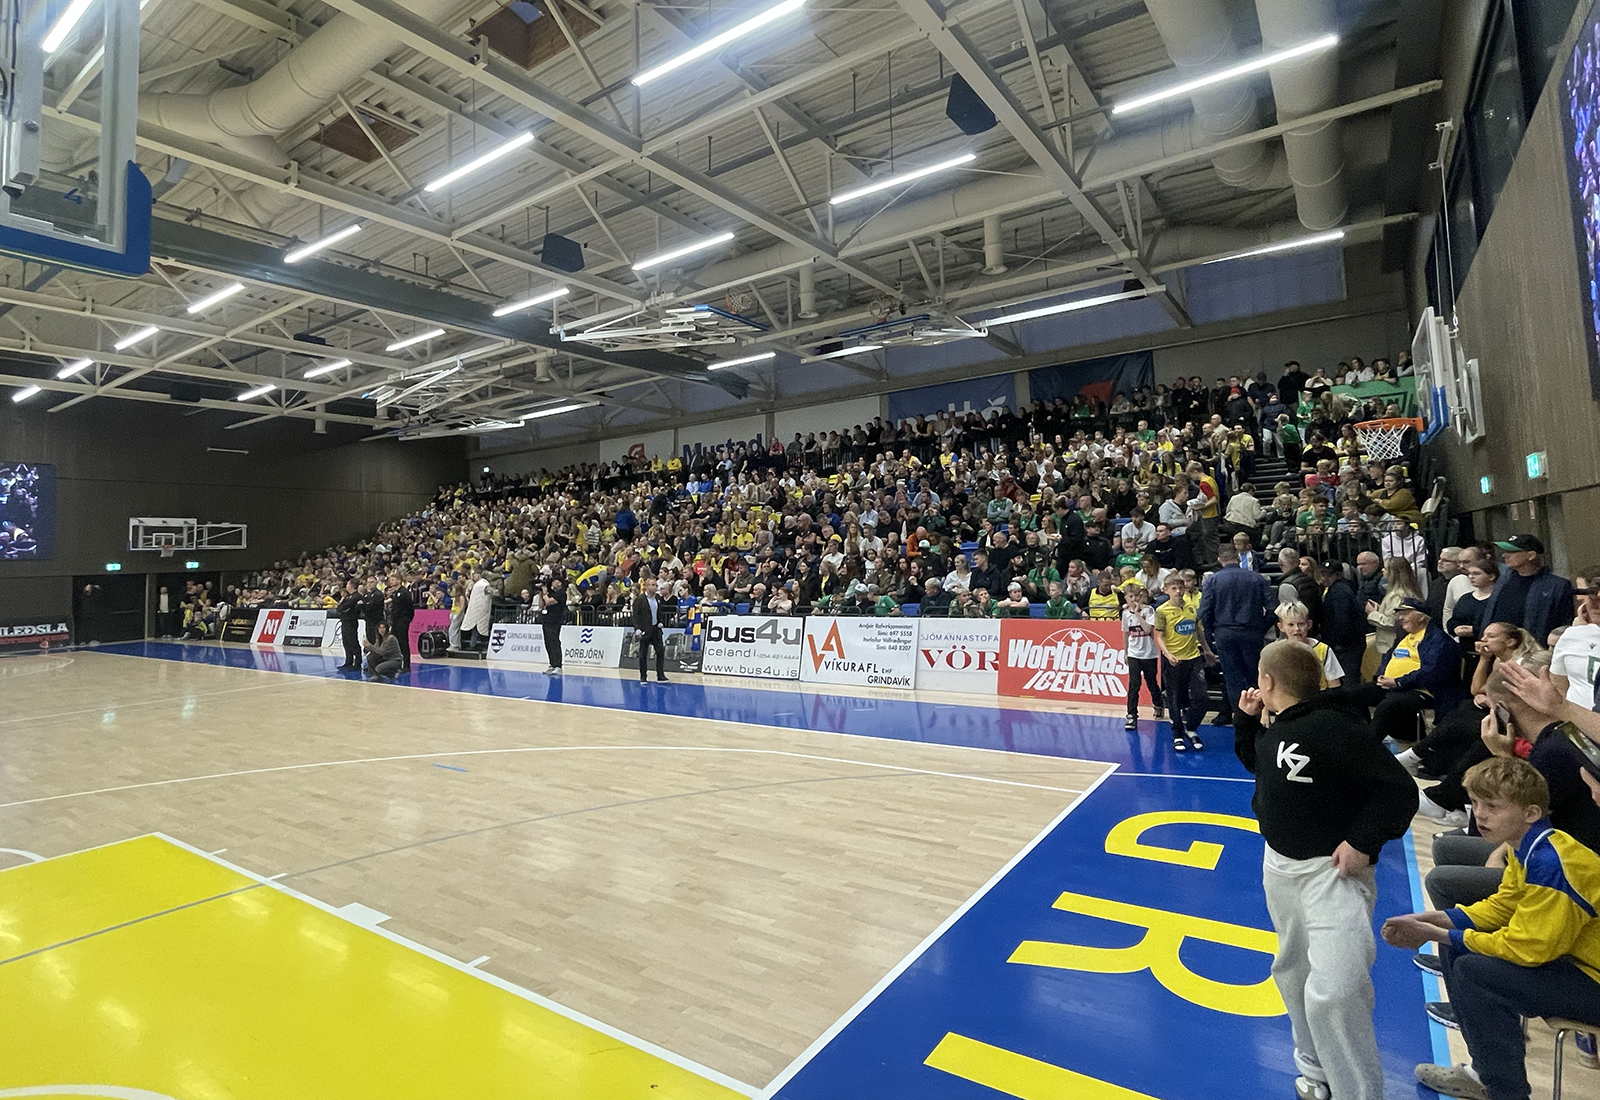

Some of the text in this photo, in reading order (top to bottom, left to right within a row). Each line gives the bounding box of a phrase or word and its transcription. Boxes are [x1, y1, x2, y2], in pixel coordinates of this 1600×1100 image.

[264, 619, 280, 635] N1
[707, 619, 801, 645] bus4u
[920, 633, 999, 642] SJÓMANNASTOFA
[704, 646, 751, 658] Iceland
[920, 644, 999, 671] VÖR
[1077, 641, 1129, 675] Clas
[704, 664, 798, 677] www.bus4u.is
[824, 658, 878, 673] VÍKURAFL
[867, 675, 910, 686] GRINDAVÍK
[1022, 670, 1127, 697] ICELAND
[1277, 741, 1313, 783] KZ
